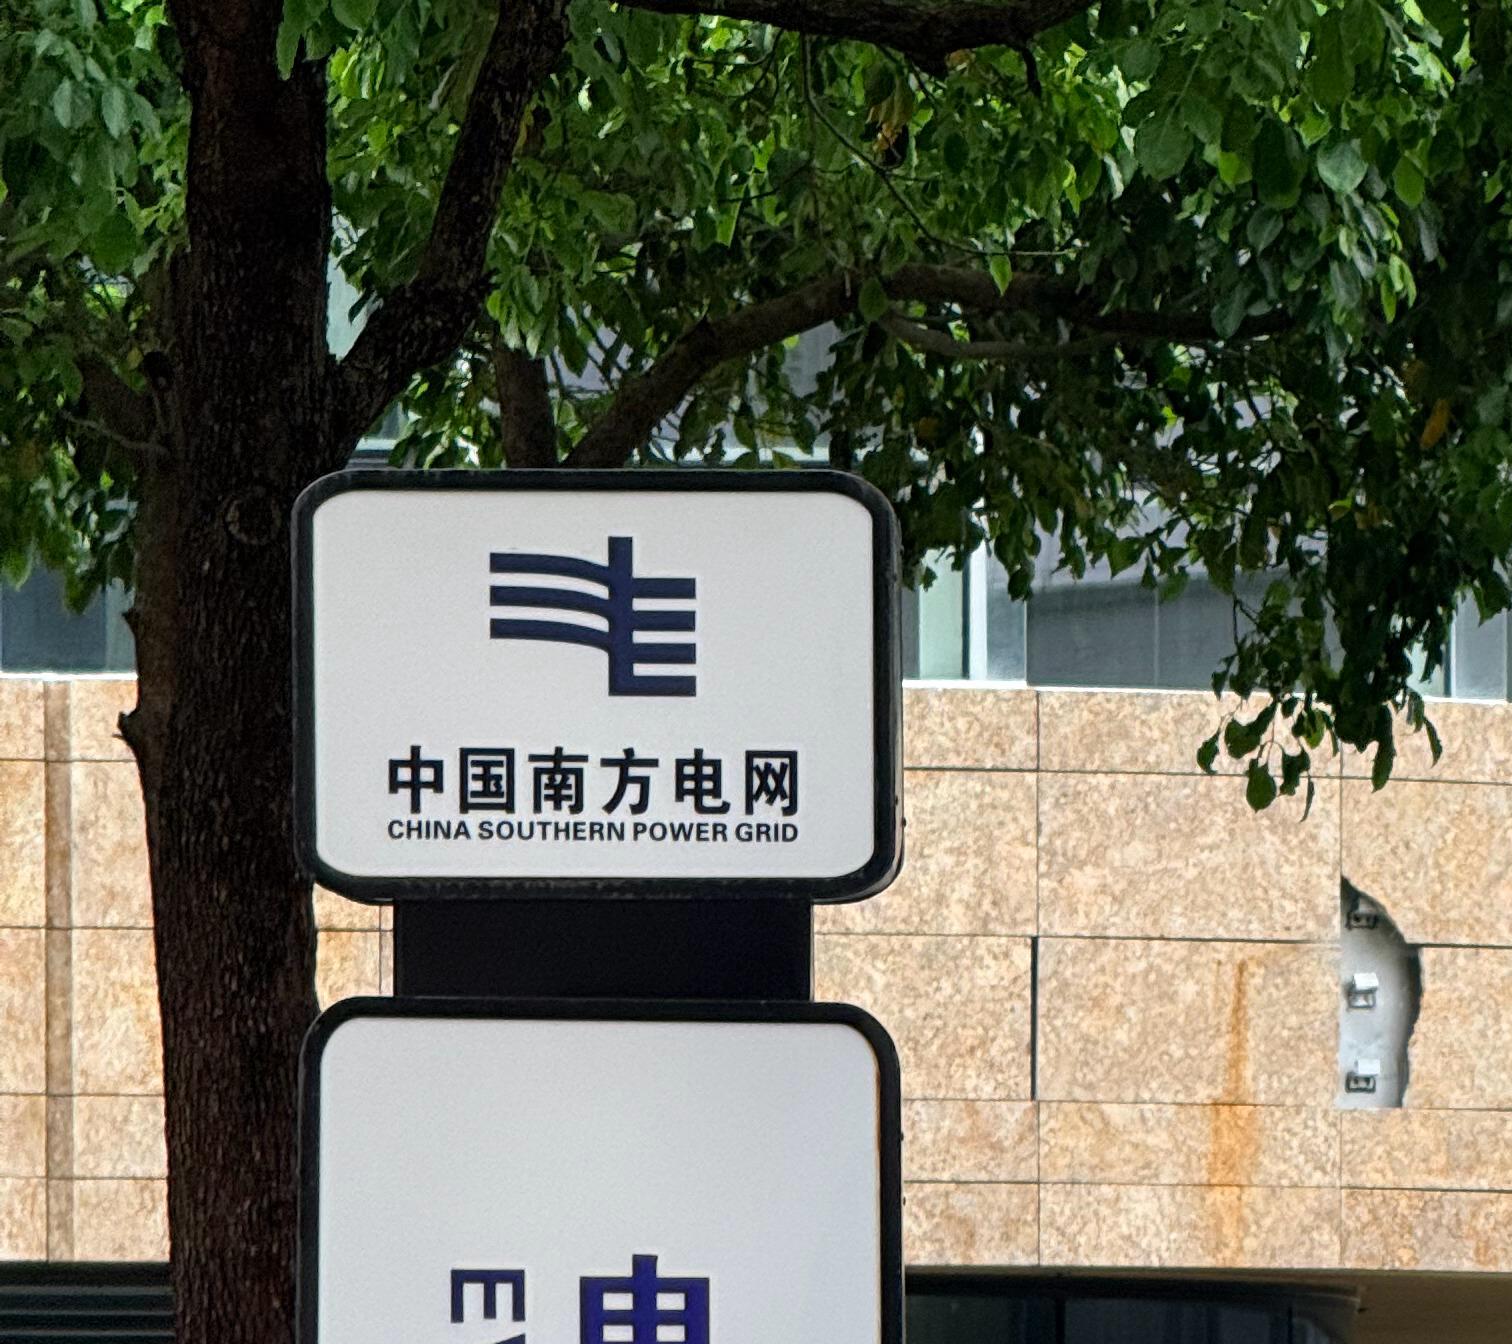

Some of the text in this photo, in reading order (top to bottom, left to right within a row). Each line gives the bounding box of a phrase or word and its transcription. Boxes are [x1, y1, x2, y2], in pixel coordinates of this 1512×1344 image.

[388, 745, 799, 817] 中国南方电网
[387, 819, 799, 843] CHINA SOUTHERN POWER GRID
